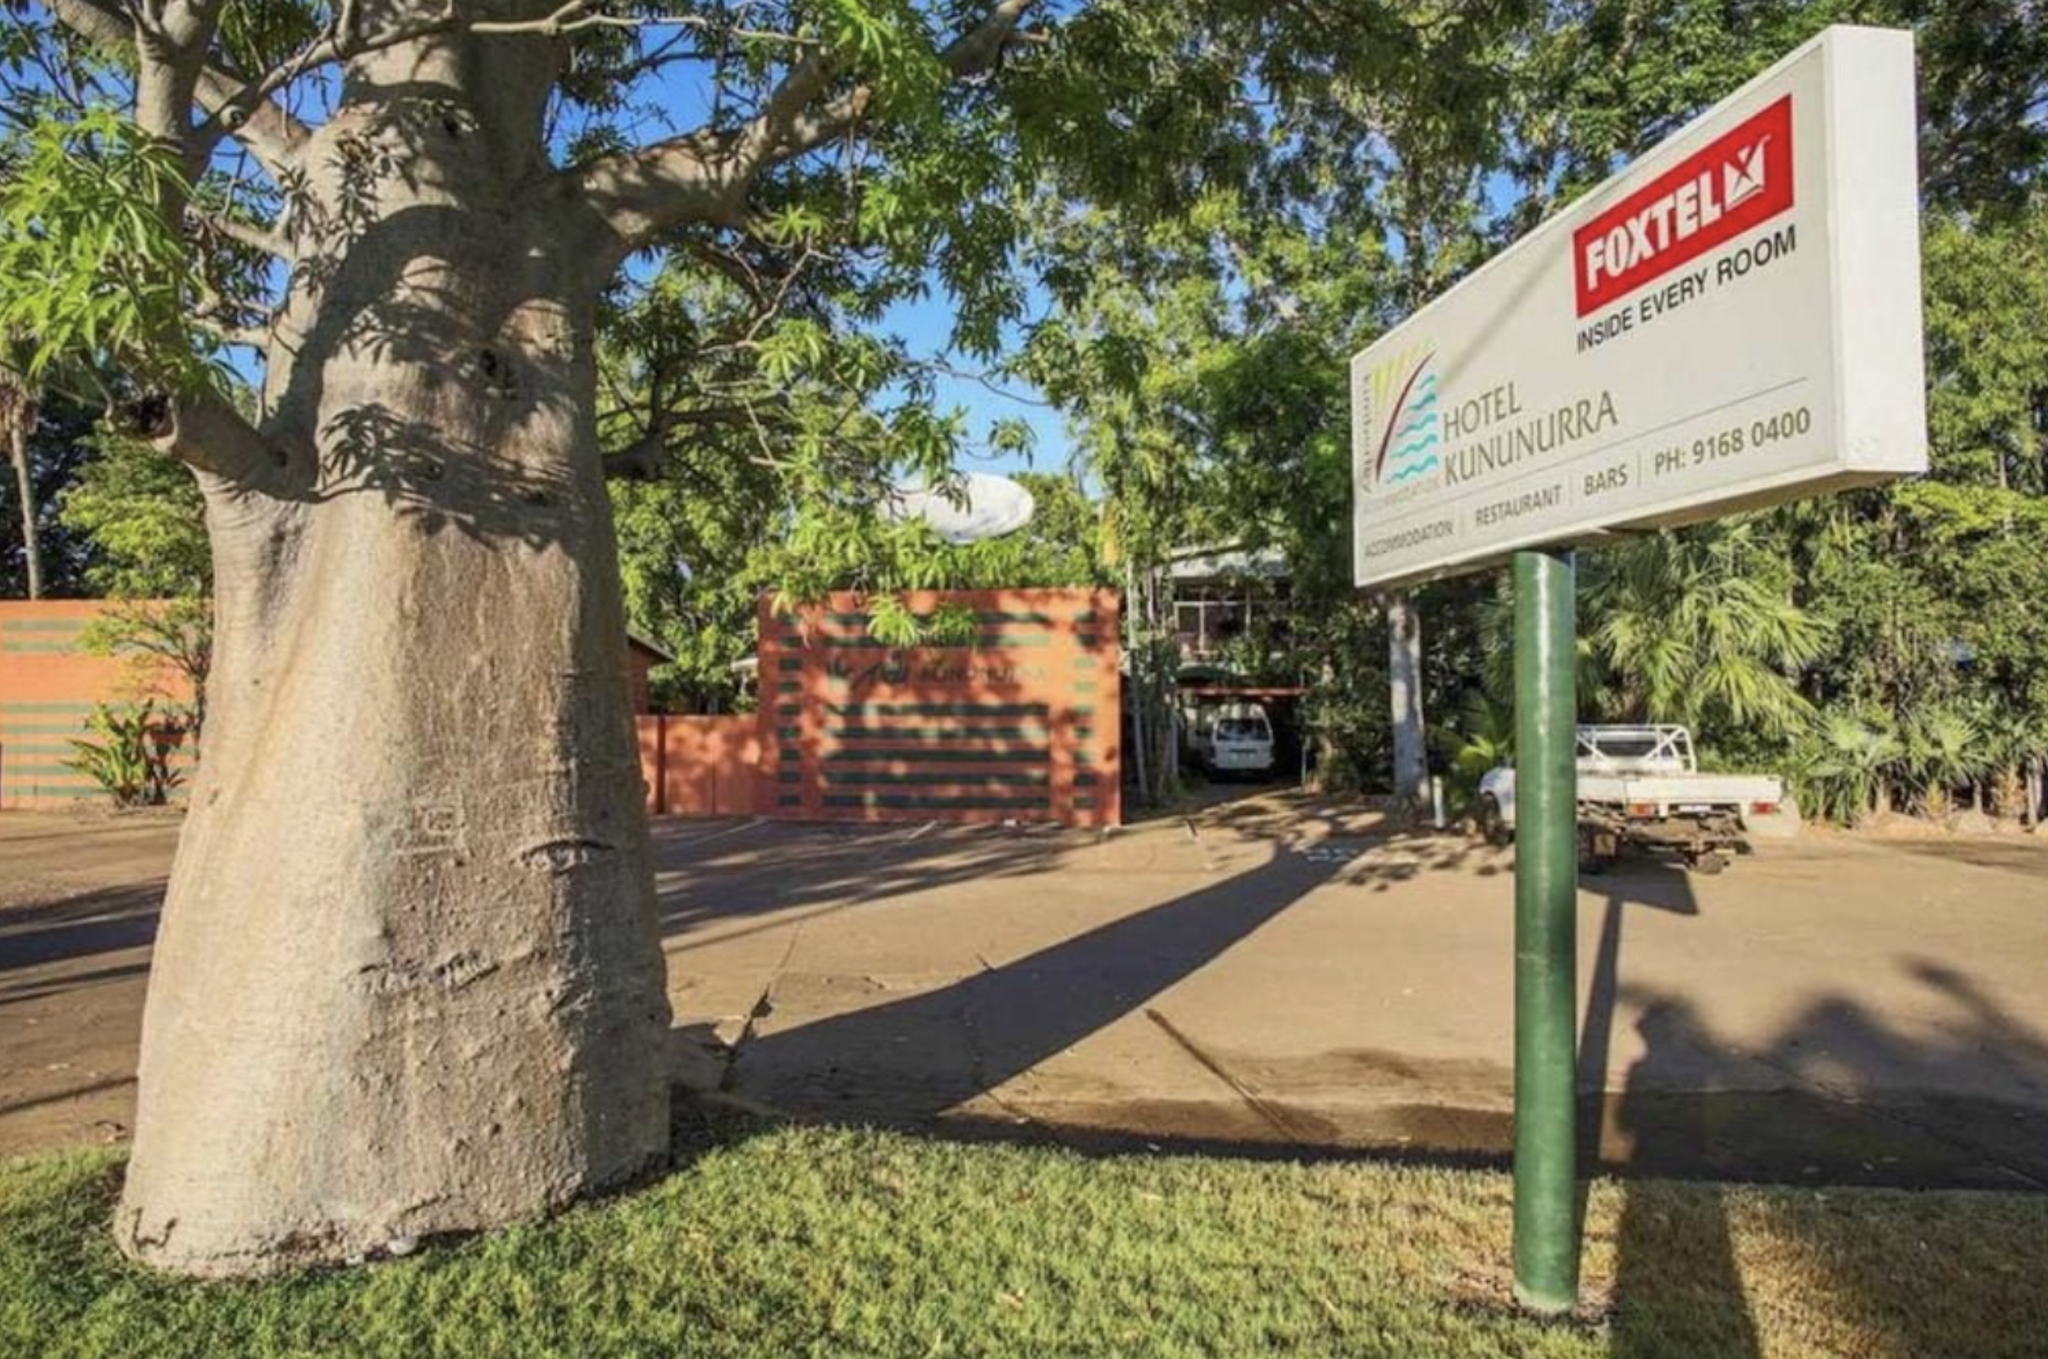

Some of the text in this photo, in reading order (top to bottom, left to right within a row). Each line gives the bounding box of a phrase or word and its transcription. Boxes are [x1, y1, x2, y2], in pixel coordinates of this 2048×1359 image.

[1577, 225, 1796, 353] INSIDE EVERY ROOM
[1585, 170, 1721, 291] FOXTEL
[1444, 382, 1522, 441] HOTEL
[1444, 390, 1619, 486] KUNUNURRA
[1475, 485, 1561, 527] RESTAURANT
[1583, 464, 1628, 495] BARS
[1654, 450, 1686, 475] PH:
[1693, 428, 1744, 464] 9168
[1751, 407, 1811, 446] 0400
